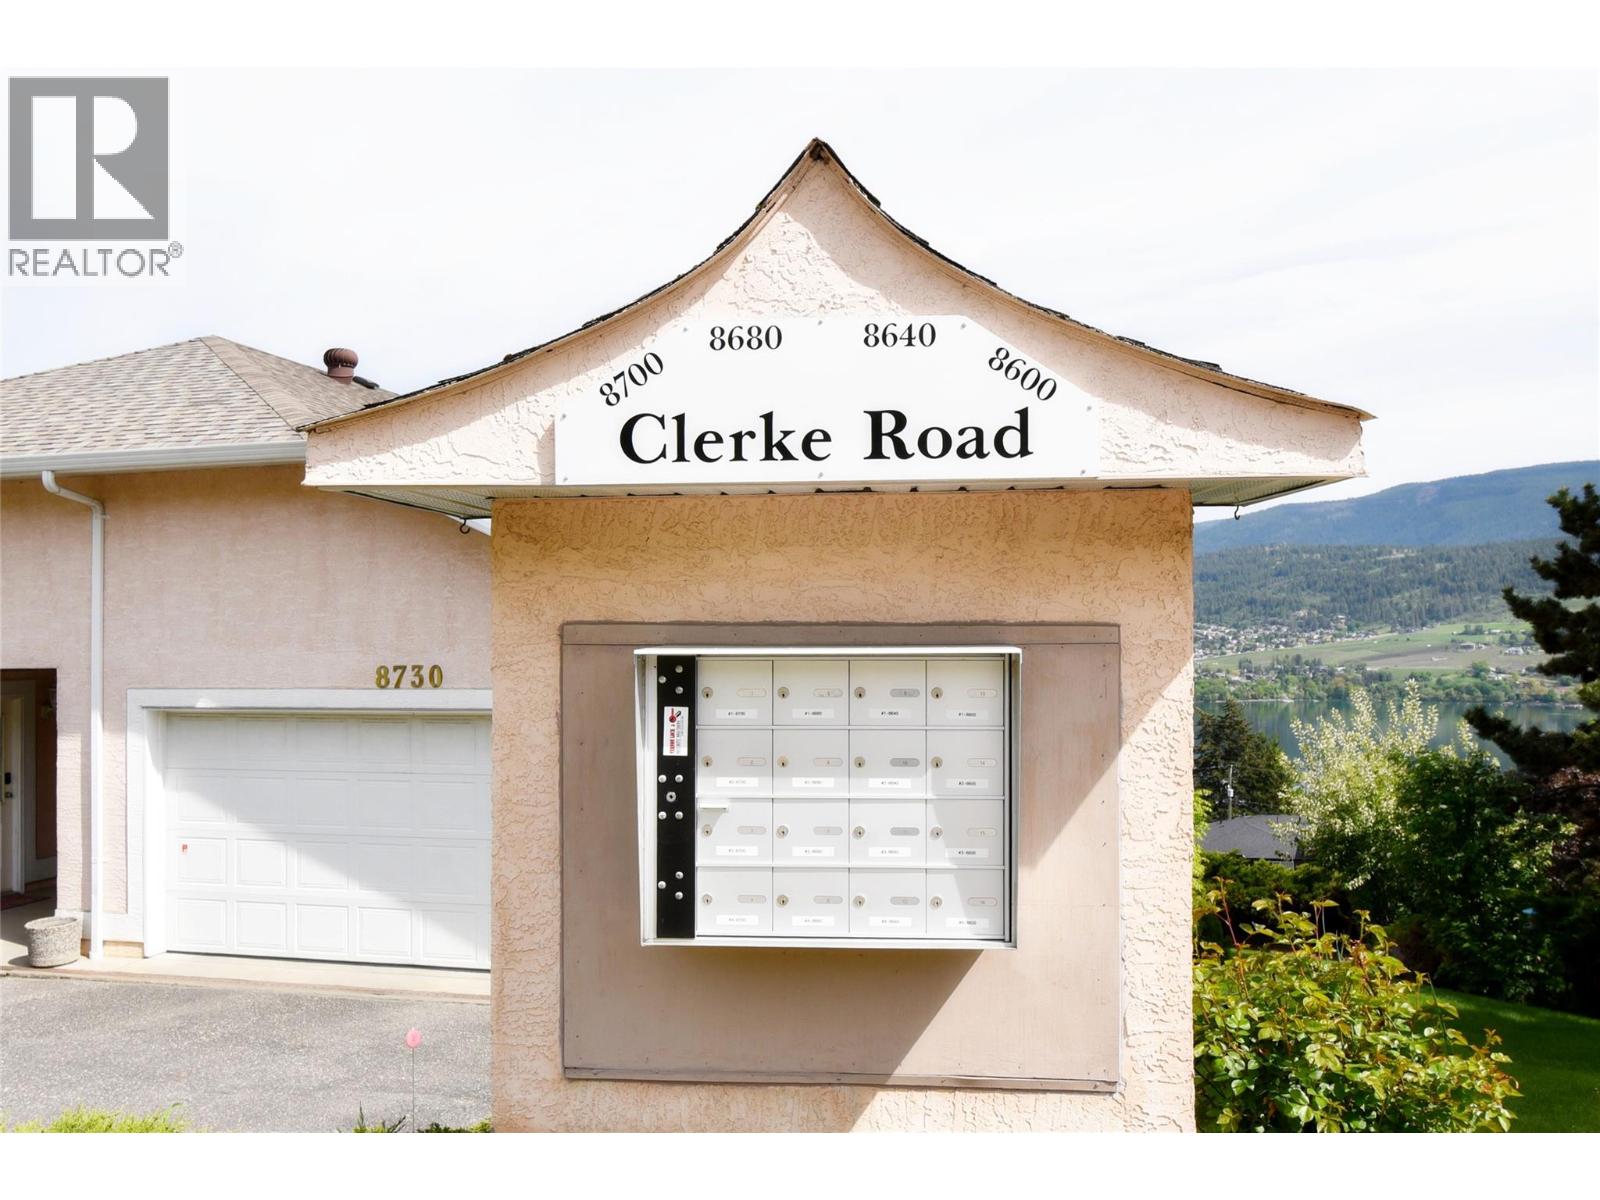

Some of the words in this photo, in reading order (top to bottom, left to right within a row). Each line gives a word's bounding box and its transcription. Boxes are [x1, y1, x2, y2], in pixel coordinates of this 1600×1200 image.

[709, 325, 782, 350] 8680
[863, 322, 936, 347] 8640
[599, 352, 664, 407] 8700
[988, 347, 1058, 401] 8600
[619, 411, 832, 464] Clerke
[863, 406, 1034, 460] Road
[375, 664, 443, 689] 8730
